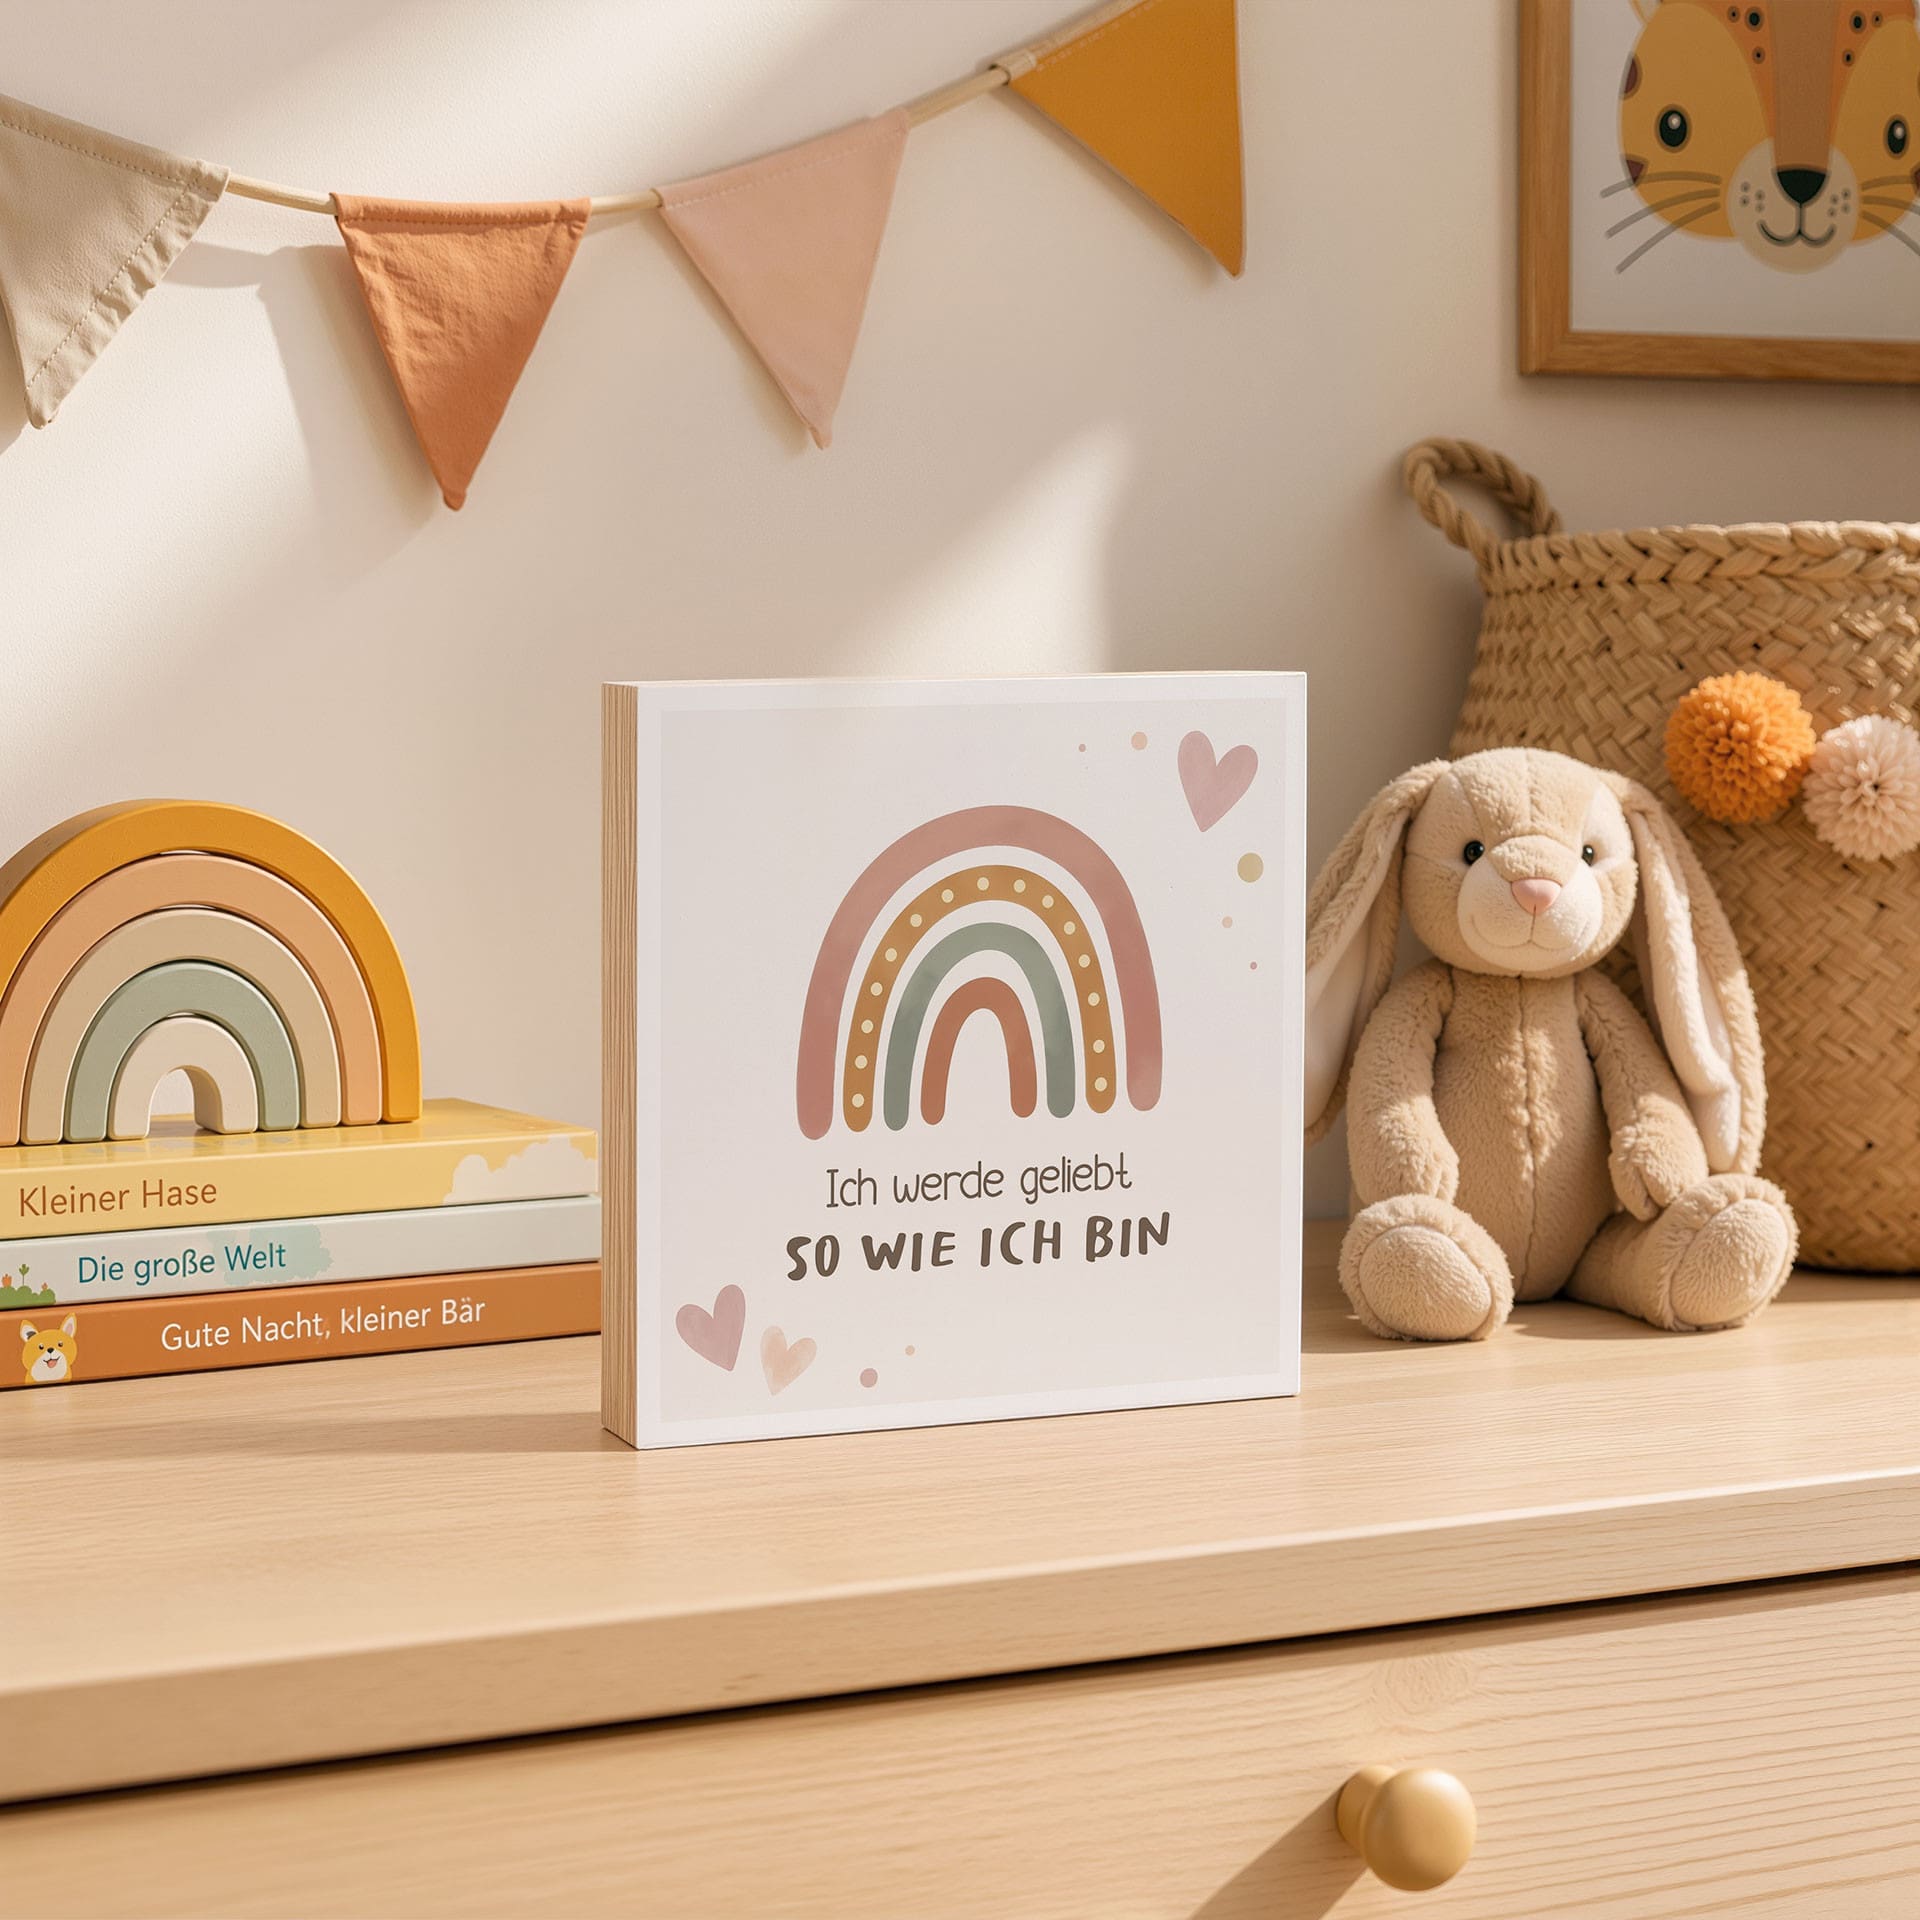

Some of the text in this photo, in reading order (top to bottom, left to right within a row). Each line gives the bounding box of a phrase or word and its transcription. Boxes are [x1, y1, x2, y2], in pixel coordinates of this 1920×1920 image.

[18, 1178, 217, 1217] Kleiner Hase
[826, 1152, 1133, 1208] Ich werde geliebt
[78, 1242, 287, 1286] Die große Welt
[786, 1211, 1170, 1281] SO WIE ICH BIN
[161, 1297, 486, 1351] Gute Nacht, kleiner Bär
